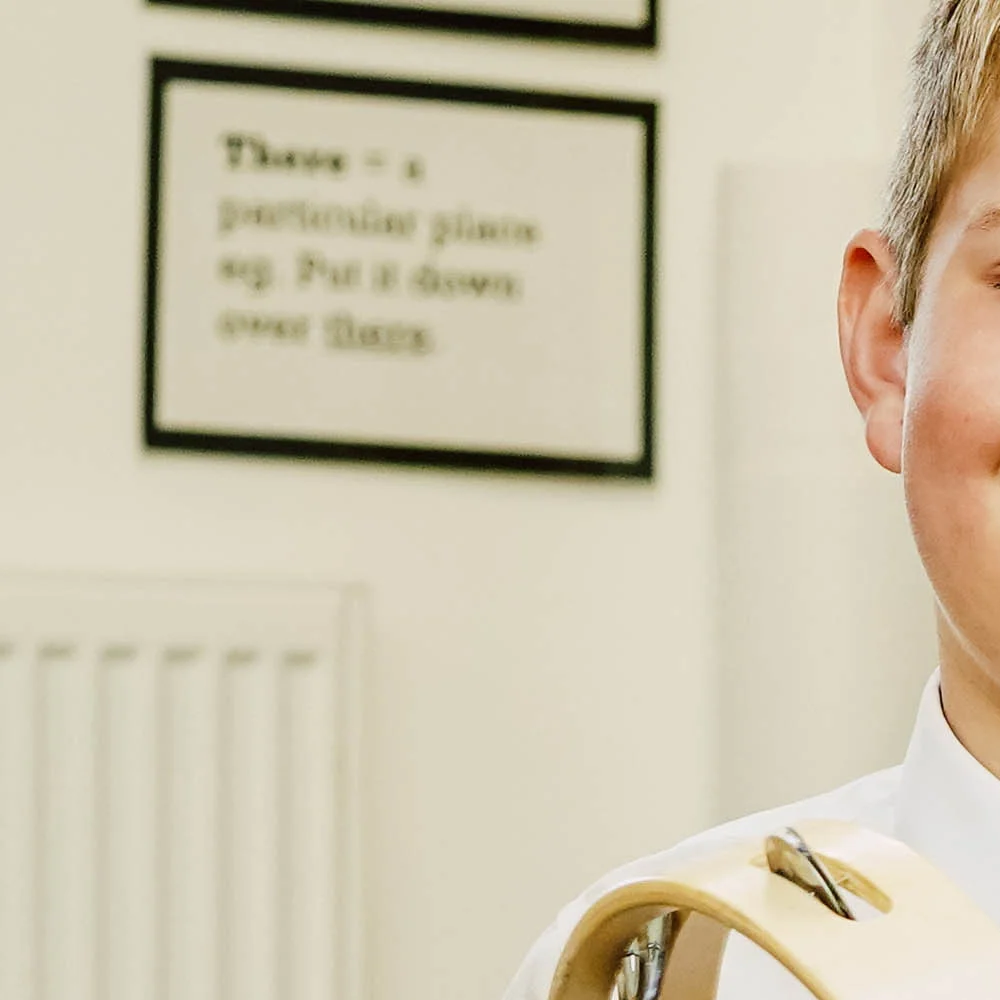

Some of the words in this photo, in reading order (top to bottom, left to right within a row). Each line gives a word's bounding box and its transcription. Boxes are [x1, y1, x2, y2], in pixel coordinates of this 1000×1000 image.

[220, 131, 348, 177] There
[218, 198, 415, 241] particular
[430, 207, 541, 249] place
[297, 250, 360, 291] Put
[410, 264, 523, 302] down
[217, 311, 308, 343] over
